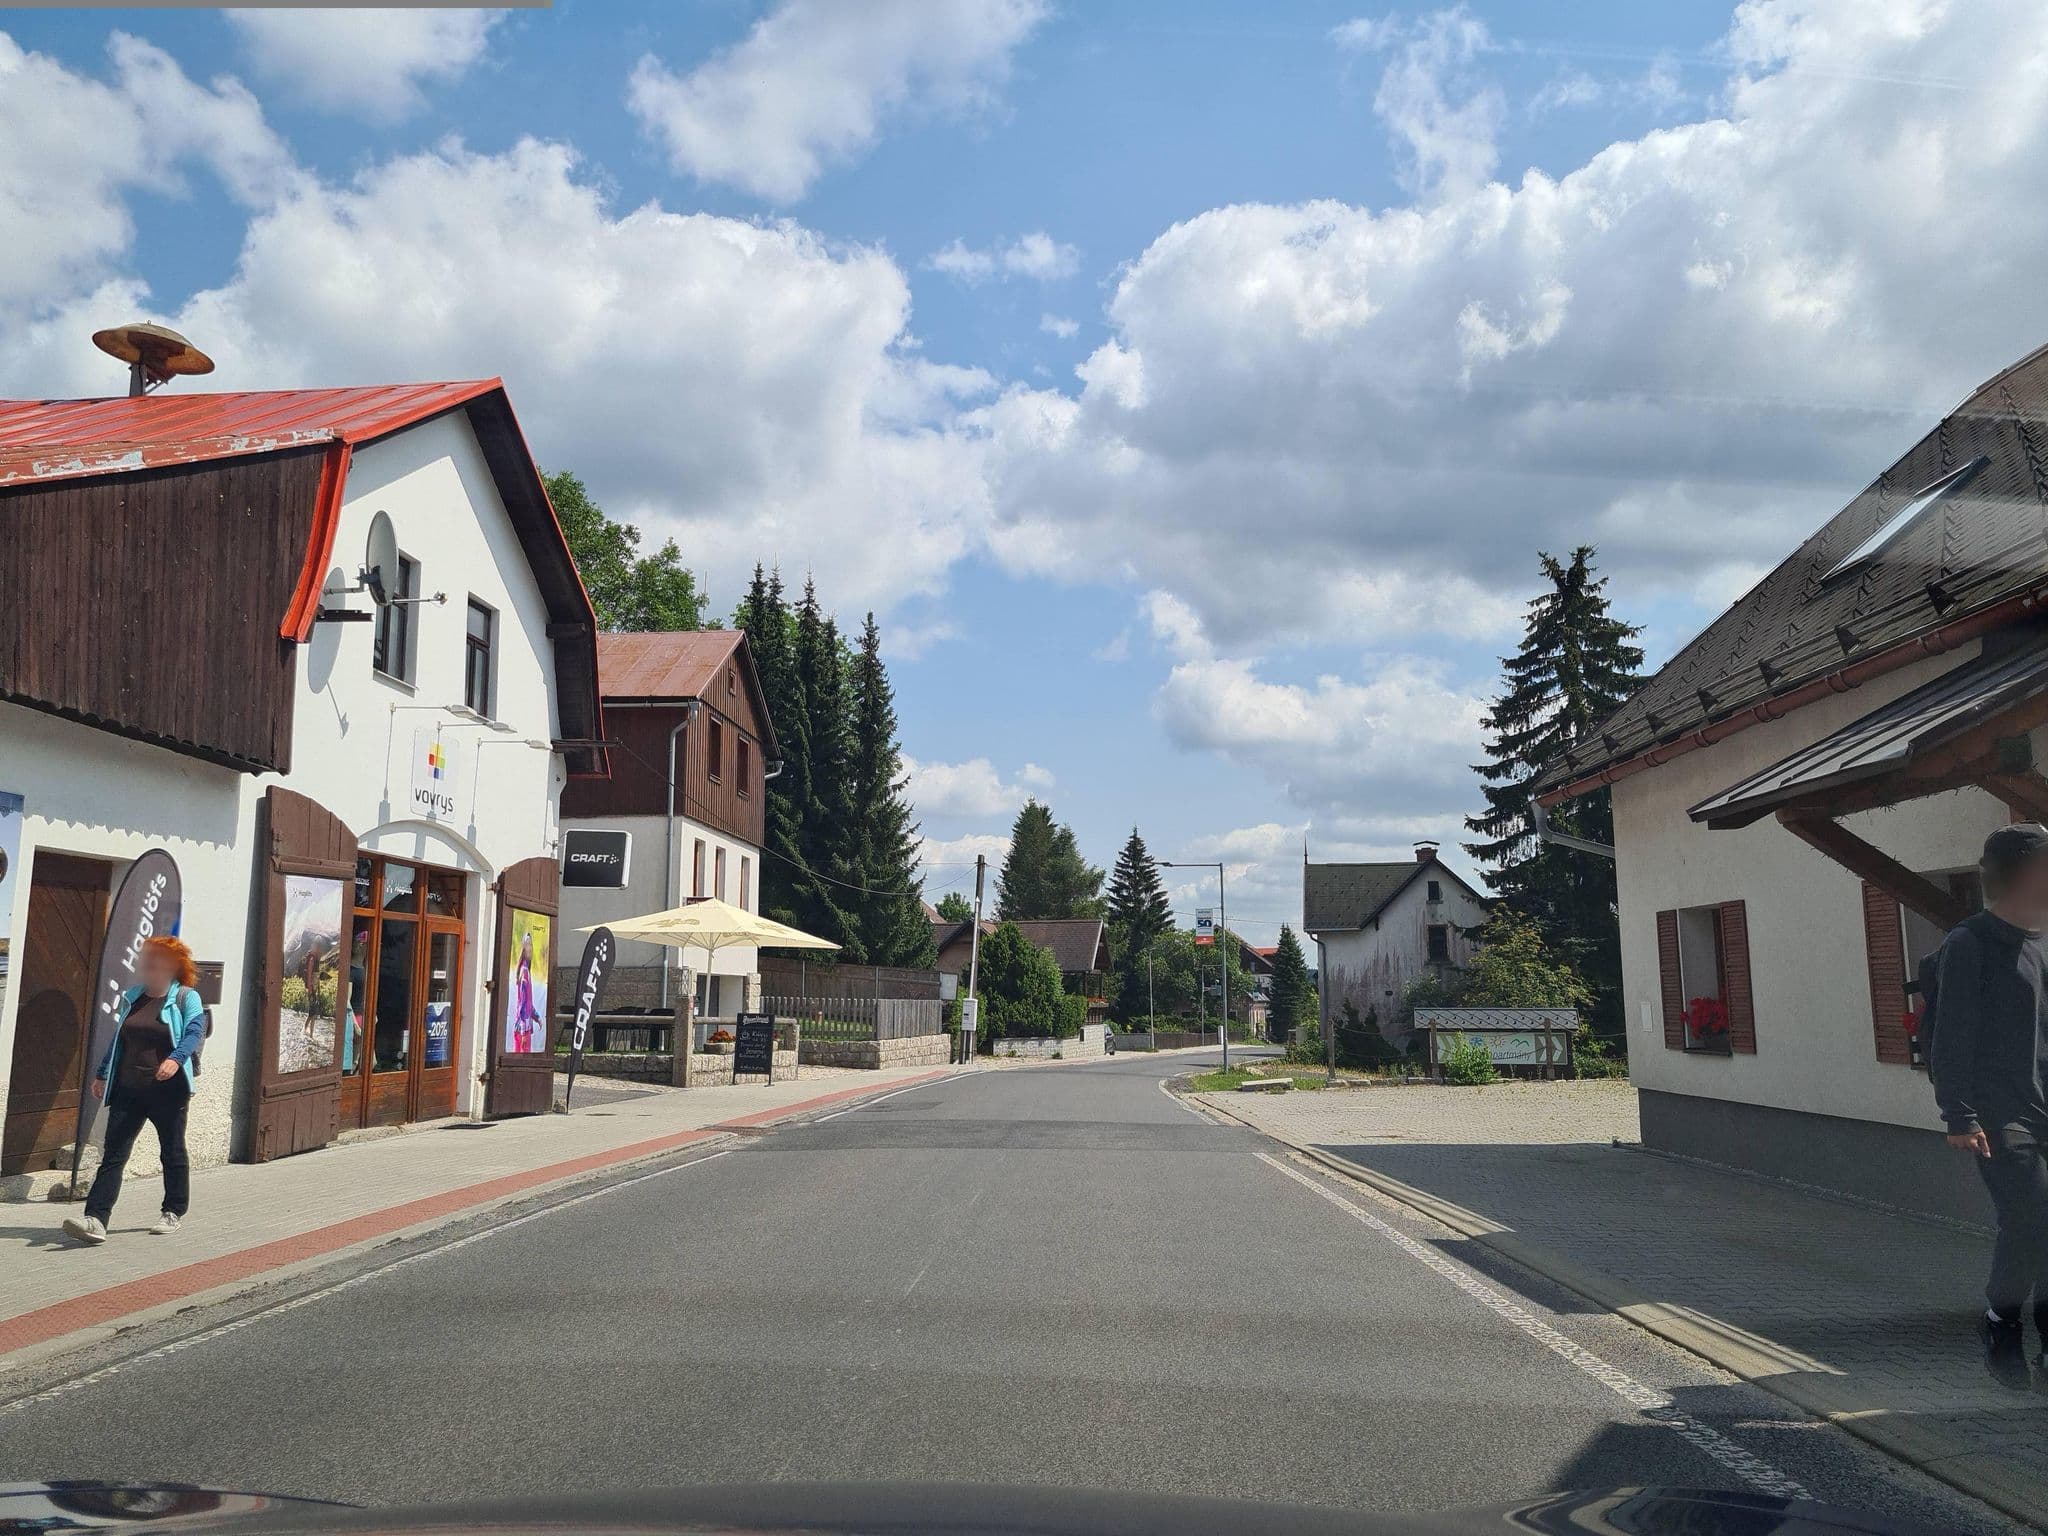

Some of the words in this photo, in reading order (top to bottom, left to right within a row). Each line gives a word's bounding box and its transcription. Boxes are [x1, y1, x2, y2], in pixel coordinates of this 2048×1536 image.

[414, 787, 454, 815] vavrys
[570, 853, 610, 863] CRAFT
[121, 873, 168, 973] Haglöfs
[573, 957, 602, 1050] CRAFT
[428, 1021, 448, 1037] -20%
